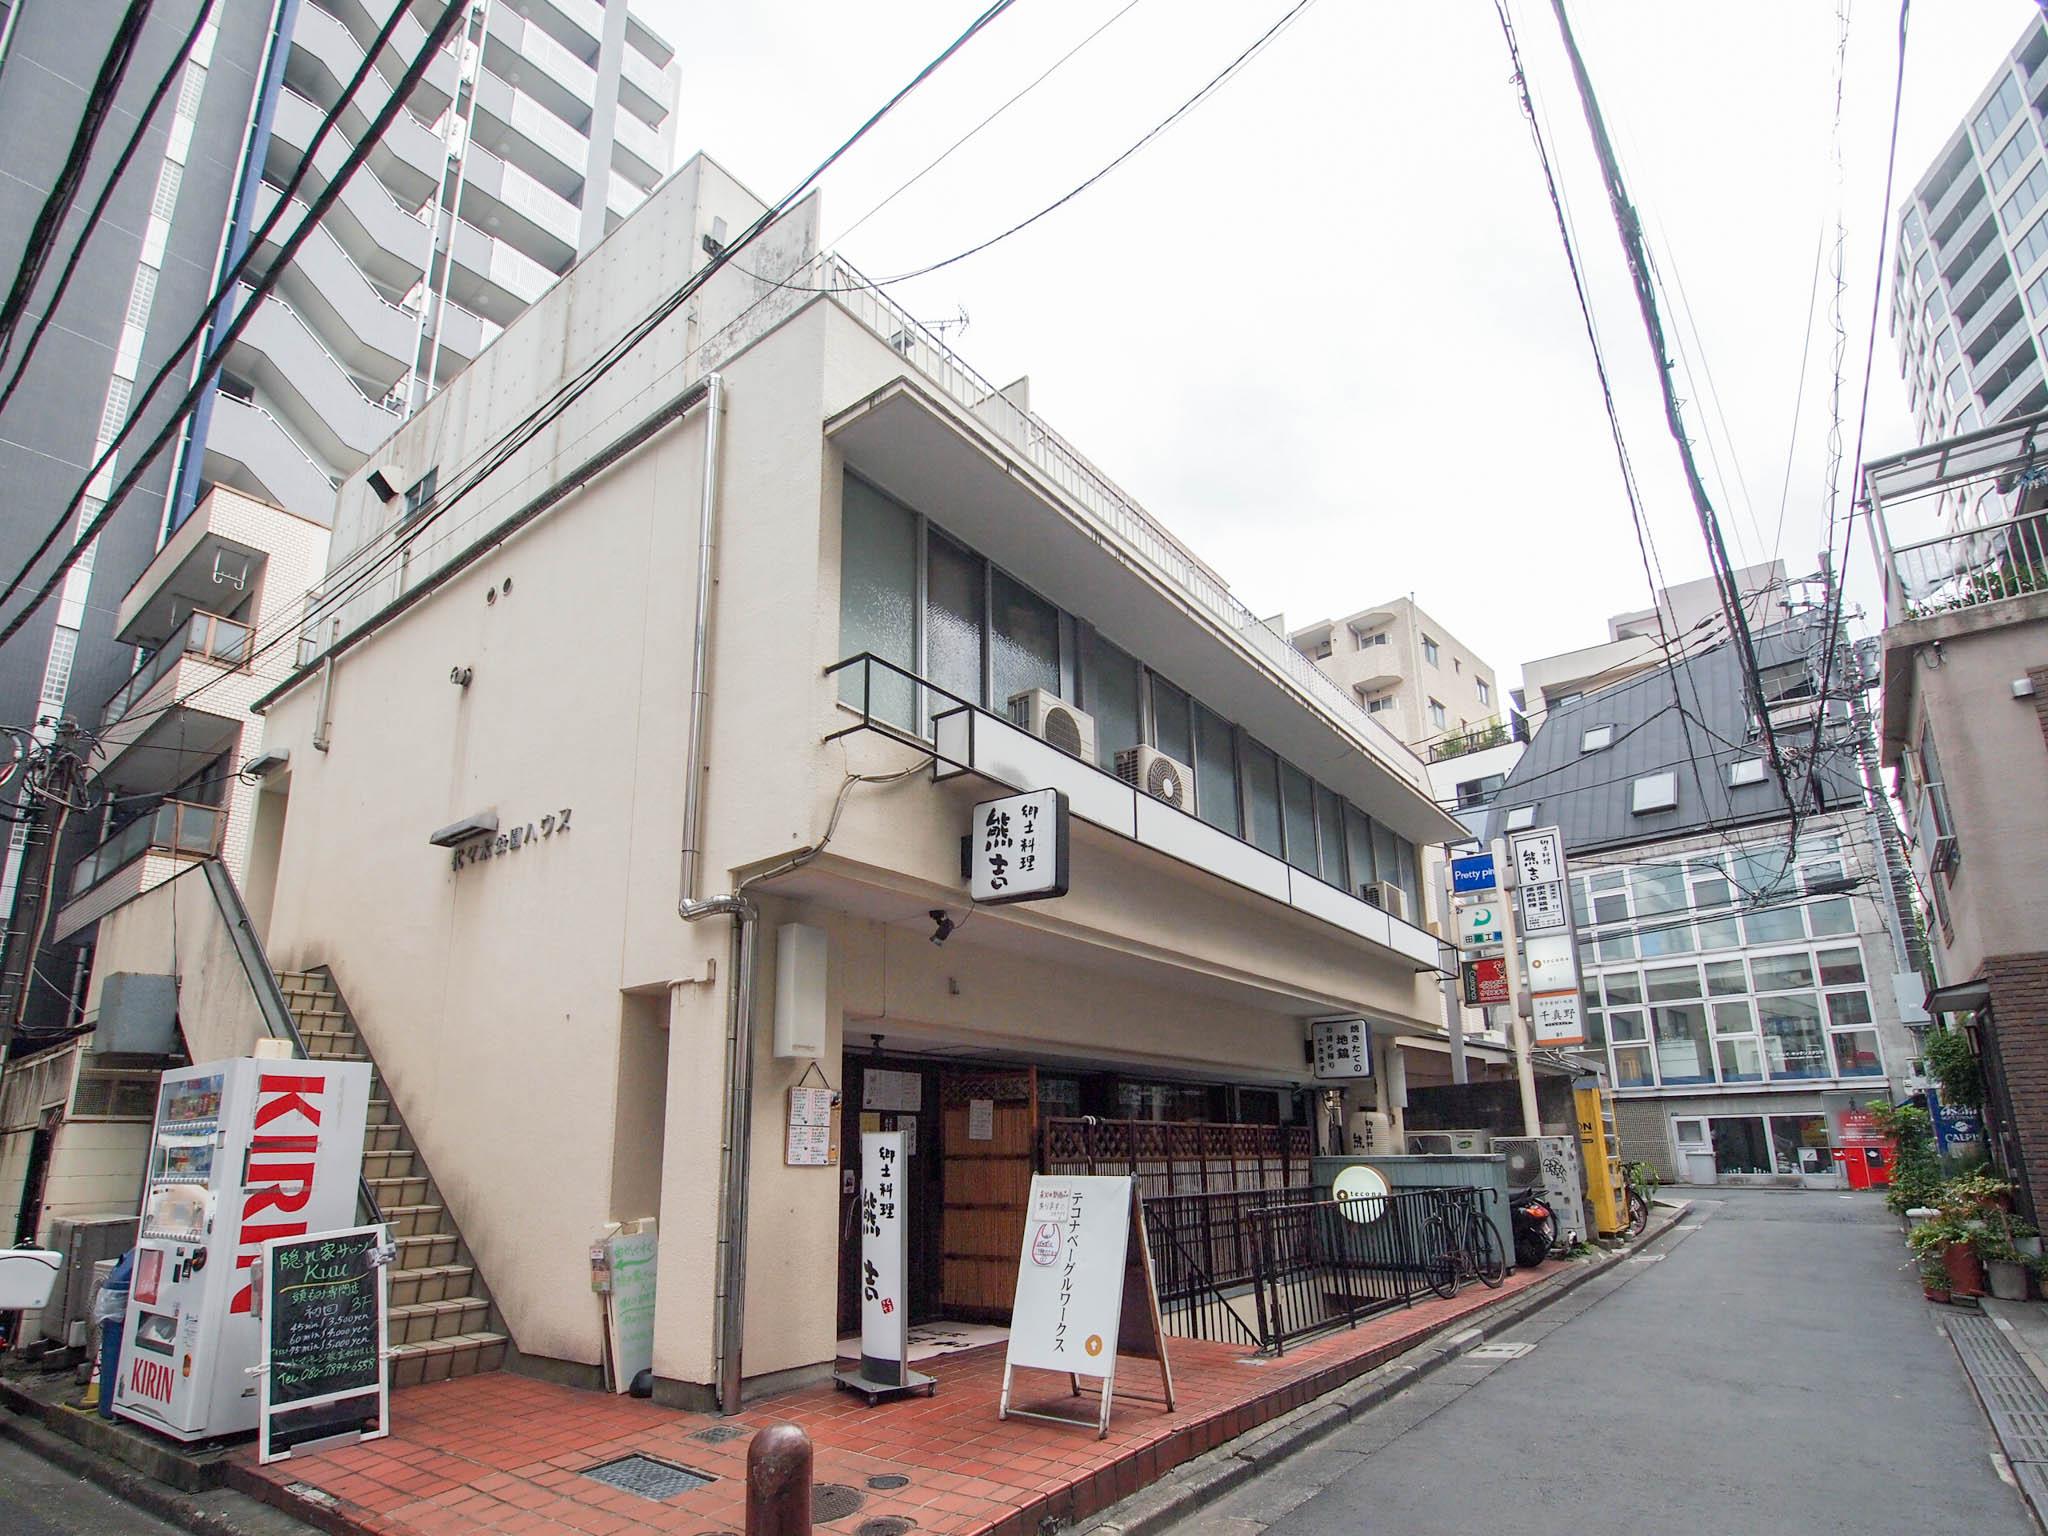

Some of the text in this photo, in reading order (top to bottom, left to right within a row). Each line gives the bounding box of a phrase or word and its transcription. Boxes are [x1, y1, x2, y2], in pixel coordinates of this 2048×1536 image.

[985, 807, 1013, 890] 熊吉
[1018, 804, 1039, 872] 郷土料理
[1455, 868, 1481, 881] Pretty
[879, 1146, 896, 1220] 郷土料理
[279, 1241, 369, 1271] 隠れ家サロン
[304, 1263, 349, 1283] Kuu
[1054, 1192, 1084, 1352] テコナベーグルワークス
[351, 1294, 373, 1311] 3F
[131, 1357, 174, 1405] KIRIN
